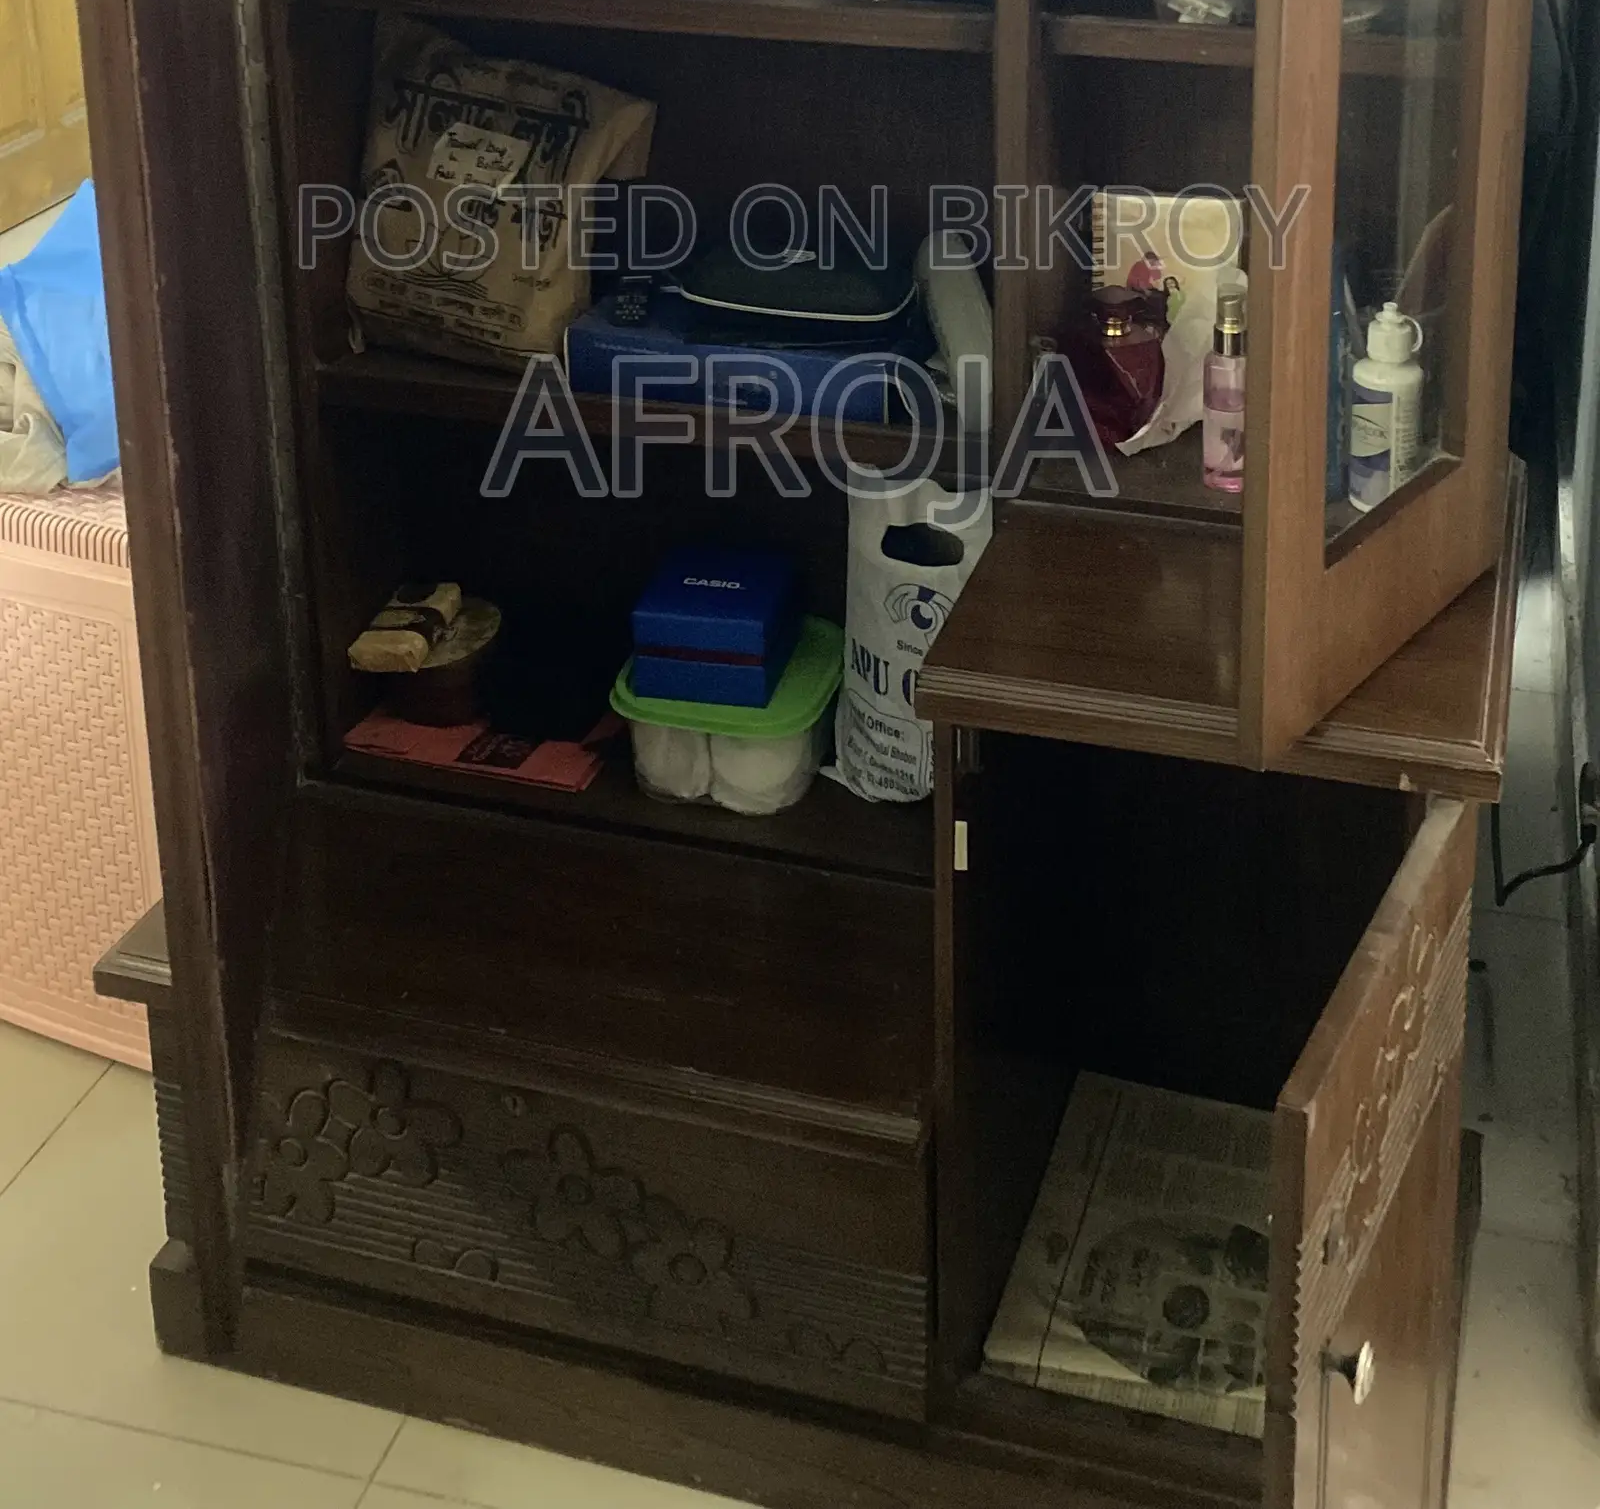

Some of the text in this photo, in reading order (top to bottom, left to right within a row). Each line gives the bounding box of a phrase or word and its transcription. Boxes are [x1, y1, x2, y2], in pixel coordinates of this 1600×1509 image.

[682, 577, 741, 590] CASIO
[896, 639, 923, 657] Since
[851, 637, 890, 697] APU
